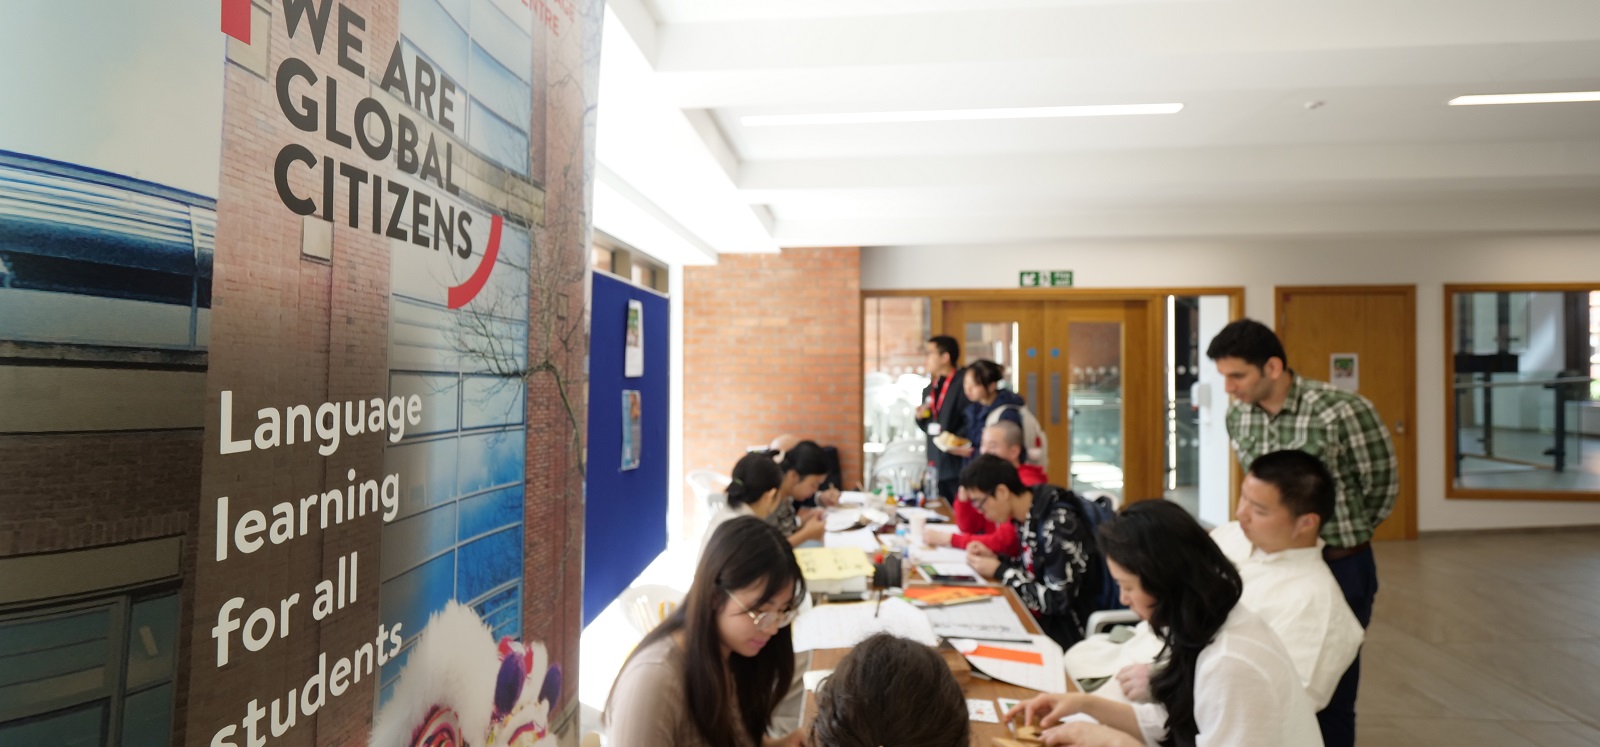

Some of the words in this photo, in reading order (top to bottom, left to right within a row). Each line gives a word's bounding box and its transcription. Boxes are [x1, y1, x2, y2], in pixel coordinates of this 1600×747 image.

[280, 0, 366, 79] WE
[380, 40, 456, 132] ARE
[275, 57, 460, 197] GLOBAL
[273, 143, 473, 260] CITIZENS
[220, 390, 423, 456] Language
[215, 468, 400, 562] learning
[211, 592, 301, 668] for
[312, 551, 358, 621] all
[209, 620, 404, 747] students
